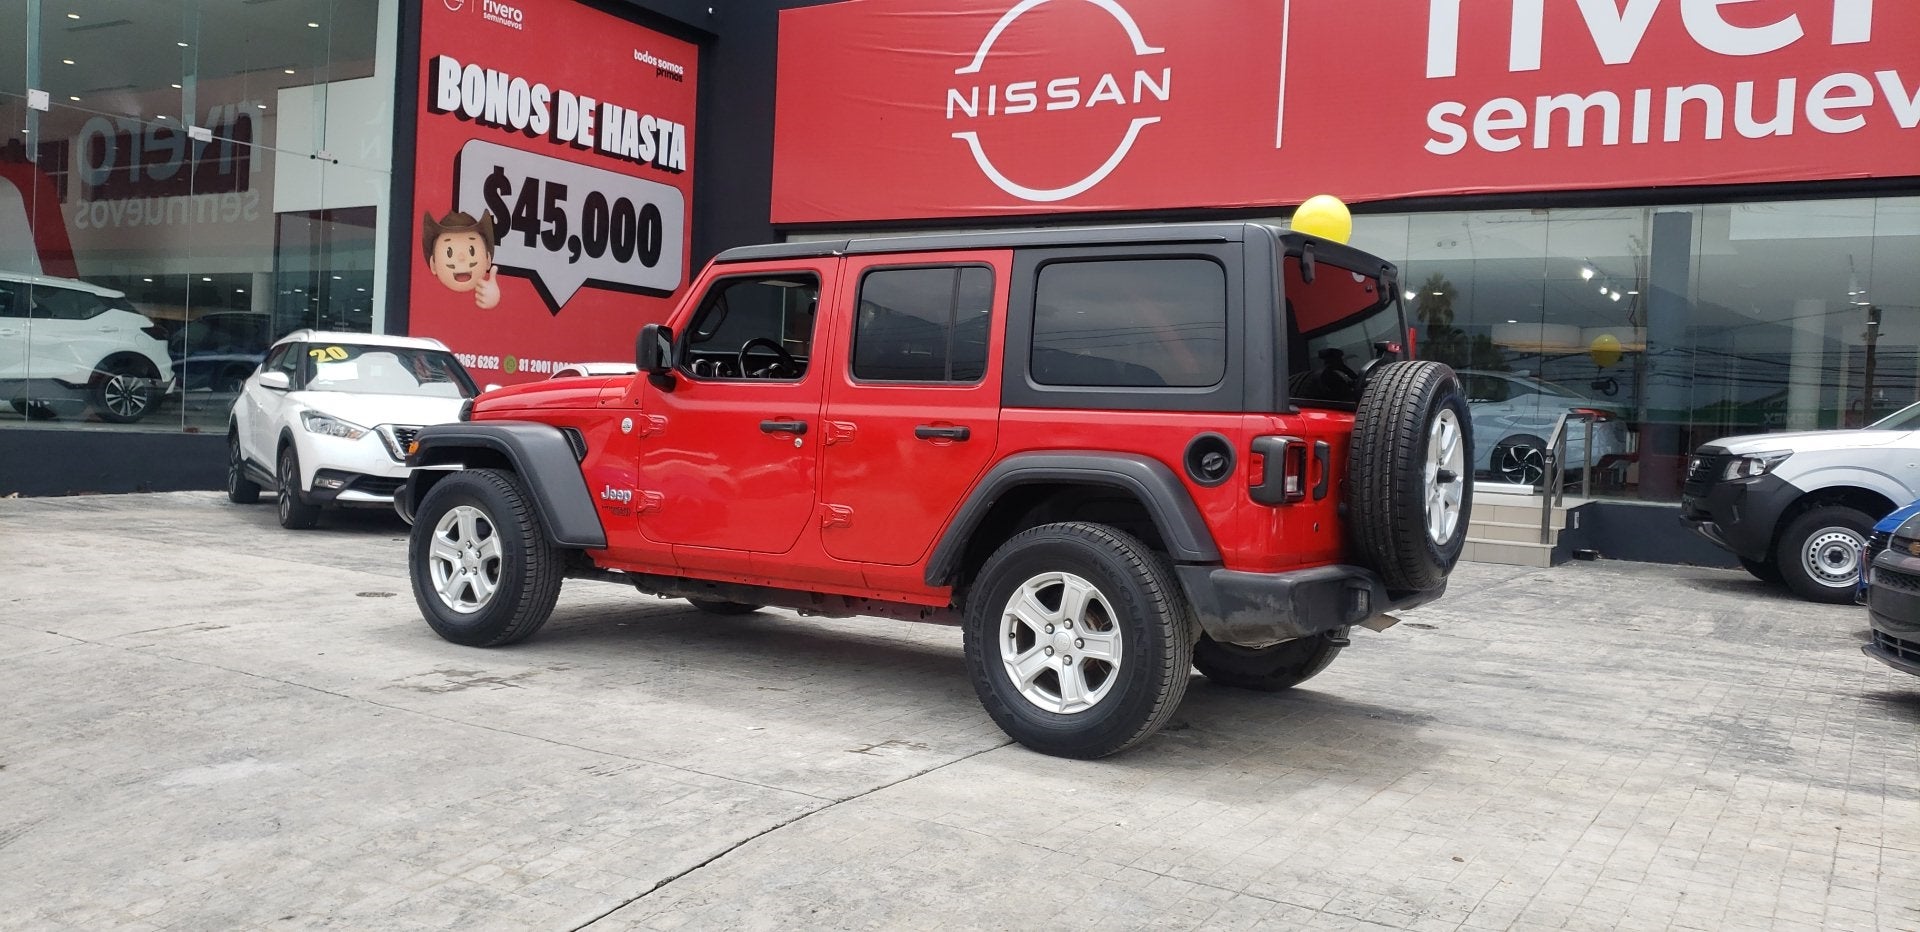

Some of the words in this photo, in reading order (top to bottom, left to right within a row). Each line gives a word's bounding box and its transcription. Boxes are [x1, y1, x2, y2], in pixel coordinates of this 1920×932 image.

[483, 0, 523, 22] rivero
[483, 12, 522, 30] seminuevos
[634, 49, 657, 66] todos
[657, 58, 684, 75] somos
[656, 67, 683, 83] primos
[946, 67, 1171, 120] NISSAN
[435, 55, 551, 136] BONOS
[555, 89, 597, 147] DE
[600, 101, 687, 172] HASTA
[482, 165, 663, 269] $45,000
[309, 346, 349, 363] 20
[477, 355, 499, 370] 6262
[519, 358, 529, 372] 81
[530, 359, 551, 374] 2001
[600, 484, 632, 505] Jeep
